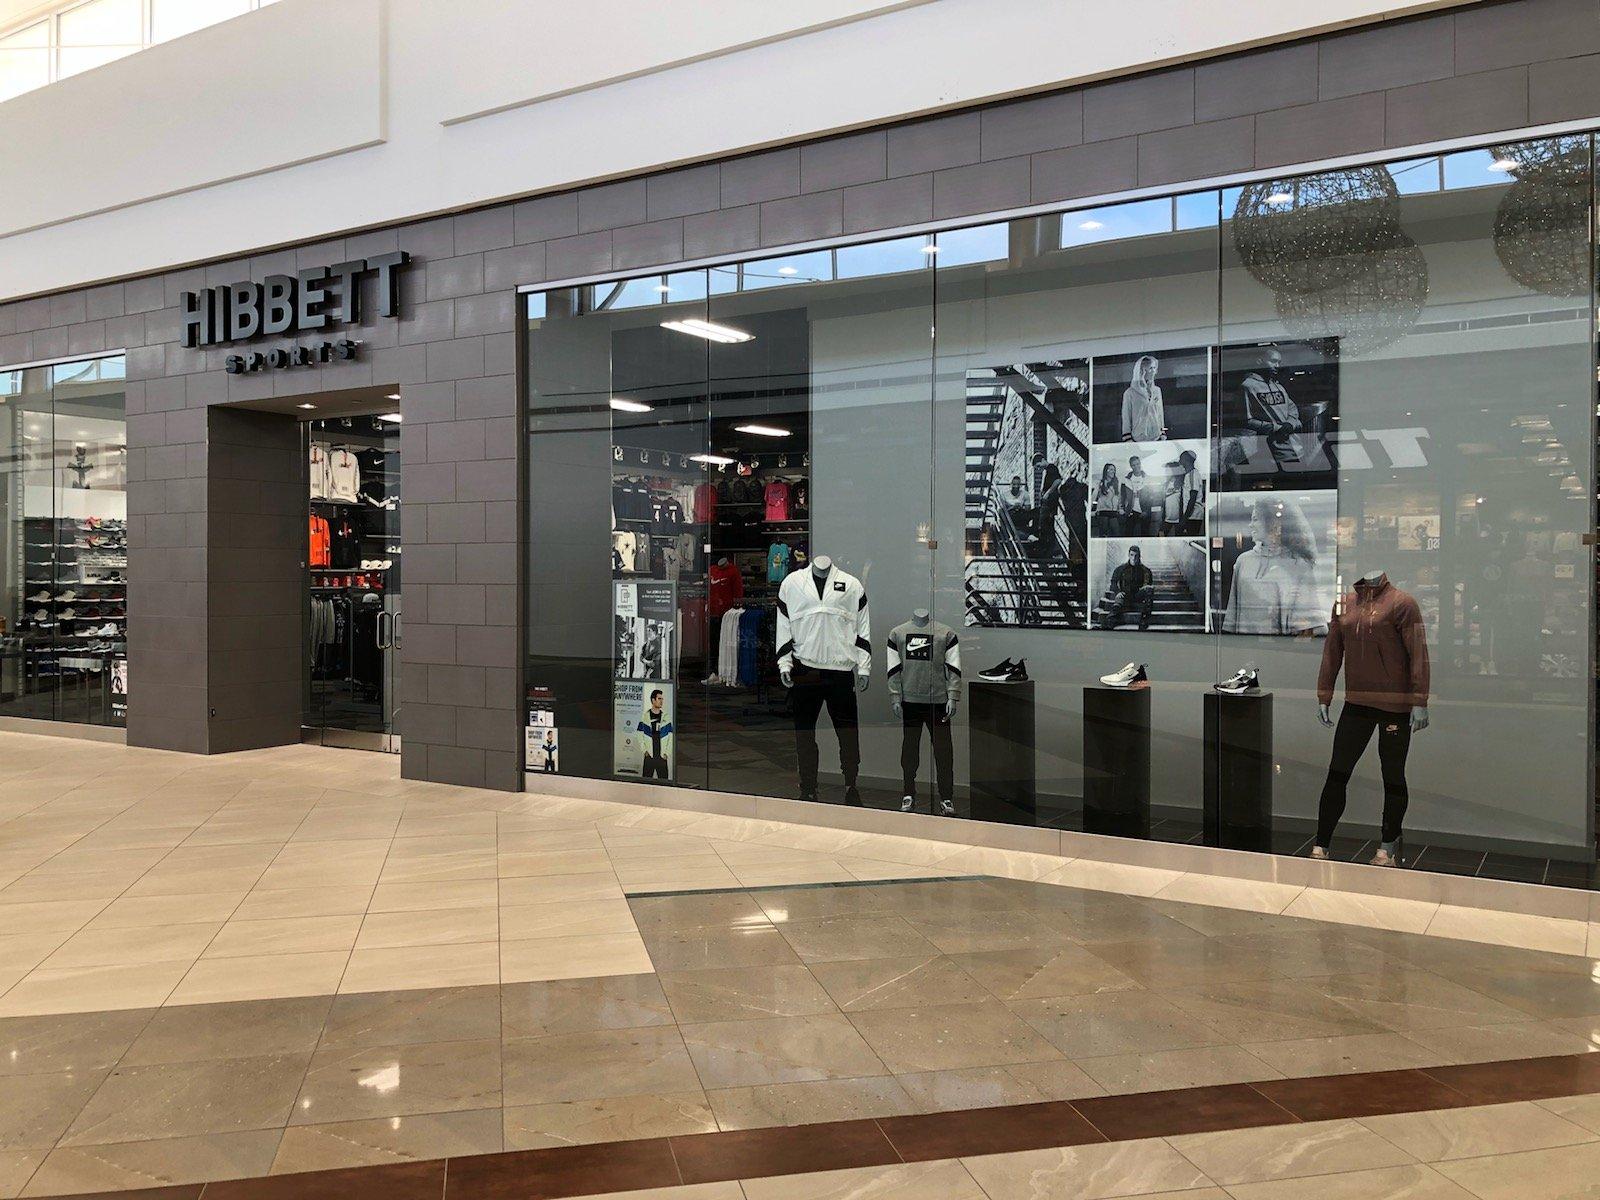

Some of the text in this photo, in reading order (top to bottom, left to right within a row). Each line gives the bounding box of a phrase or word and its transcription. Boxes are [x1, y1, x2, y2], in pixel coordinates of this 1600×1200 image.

[180, 251, 409, 347] HIBBETT
[225, 339, 356, 374] SPORTS
[614, 684, 643, 693] SHOP FROM
[614, 692, 643, 700] ANYWHERE
